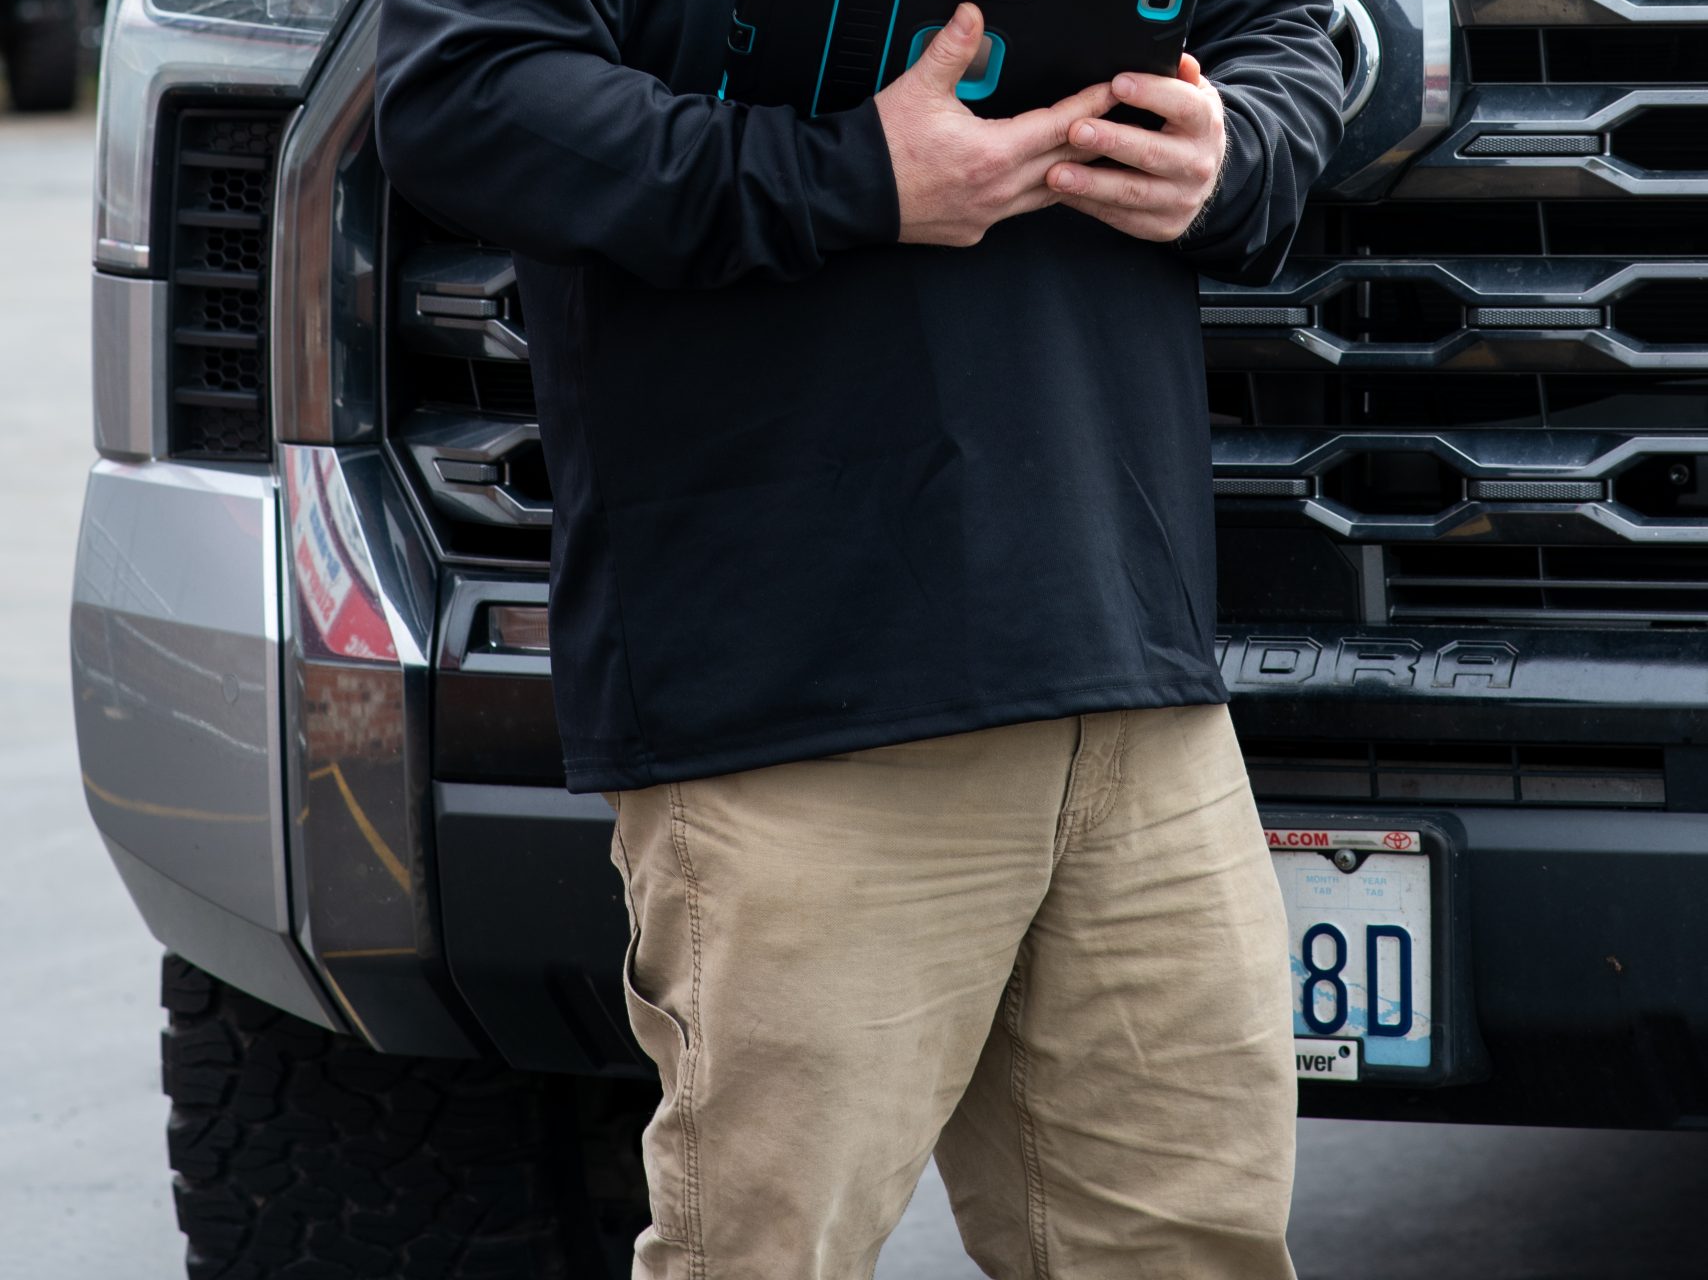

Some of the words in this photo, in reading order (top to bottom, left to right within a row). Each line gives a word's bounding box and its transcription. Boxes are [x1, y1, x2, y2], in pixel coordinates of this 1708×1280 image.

[1305, 875, 1340, 884] MONTH
[1360, 877, 1387, 885] YEAR
[1313, 886, 1332, 895] TAB
[1365, 888, 1384, 897] TAB
[1302, 923, 1412, 1037] 8D
